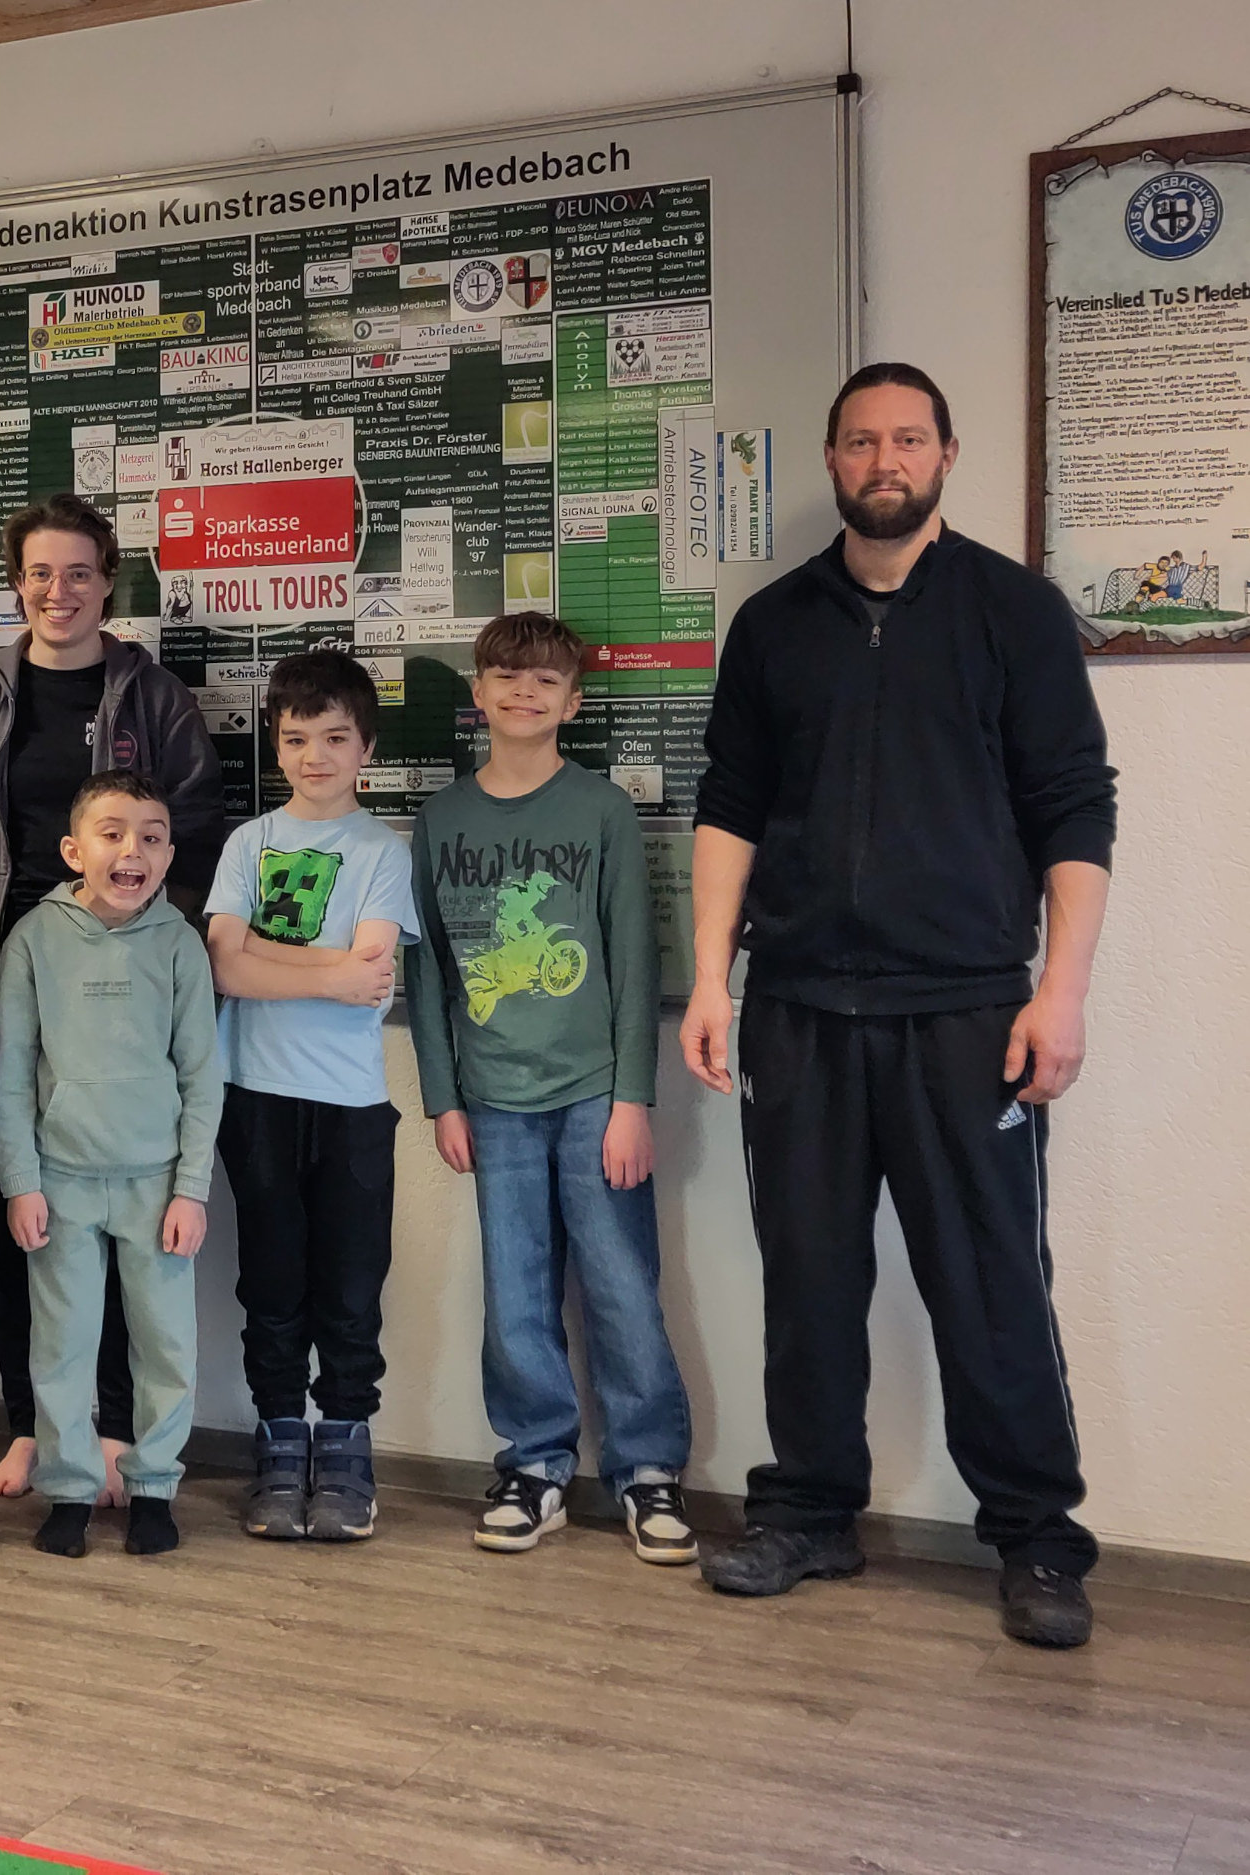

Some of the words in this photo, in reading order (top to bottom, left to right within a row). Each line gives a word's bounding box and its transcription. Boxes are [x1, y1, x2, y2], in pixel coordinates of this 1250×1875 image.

[159, 170, 431, 228] Kunstrasenplatz
[445, 143, 631, 193] Medebach
[1134, 176, 1207, 209] MEDEBACH
[1200, 195, 1215, 219] 1919
[411, 216, 439, 224] HANSE
[662, 221, 705, 231] Chancenlos
[1131, 212, 1144, 242] TUS
[402, 224, 447, 236] APOTHEKE
[453, 235, 472, 244] CDU
[479, 232, 498, 241] FWG
[506, 229, 523, 238] FDP
[530, 226, 548, 235] SPD
[572, 244, 608, 257] MGV
[612, 235, 688, 252] Medebach
[611, 254, 653, 263] Rebecca
[656, 249, 705, 260] Schnellen
[233, 262, 274, 277] Stadt-
[207, 275, 300, 299] sportverband
[73, 284, 144, 307] HUNOLD
[1056, 290, 1145, 313] Vereinslied
[1150, 286, 1190, 306] TuS
[217, 296, 291, 316] Medebach
[357, 305, 398, 315] Musikzug
[401, 300, 447, 311] Medebach
[74, 305, 144, 323] Malerbetrieb
[53, 321, 114, 336] Oldtimer-Club
[117, 317, 159, 331] Medebach
[163, 316, 177, 326] e.V.
[258, 329, 264, 337] In
[265, 325, 303, 337] Gedenken
[429, 325, 475, 337] brieden
[207, 333, 247, 342] Lebenslicht
[276, 340, 285, 348] an
[51, 346, 110, 361] HAST
[162, 352, 195, 369] BAU
[207, 344, 248, 365] KING
[258, 351, 281, 361] Werner
[282, 348, 304, 359] Althaus
[312, 349, 327, 357] Die
[328, 343, 394, 356] Montagsfrauen
[282, 358, 349, 371] ARCHITEKTURBÜRO
[574, 331, 591, 390] Anonym
[336, 379, 375, 390] Berthold
[387, 377, 412, 385] Sven
[415, 374, 446, 384] Sälzer
[661, 384, 710, 394] Vorstand
[314, 396, 328, 404] mit
[331, 394, 360, 403] Colleg
[363, 390, 408, 399] Treuhand
[411, 386, 442, 396] GmbH
[614, 390, 652, 399] Thomas
[659, 395, 703, 405] Fußball
[33, 408, 51, 416] ALTE
[52, 406, 83, 415] HERREN
[85, 400, 138, 412] MANNSCHAFT
[140, 399, 157, 407] 2010
[316, 408, 325, 416] u.
[327, 404, 374, 415] Busreisen
[386, 401, 406, 410] Taxi
[408, 399, 439, 409] Sälzer
[612, 401, 653, 411] Grosche
[365, 440, 408, 449] Praxis
[413, 437, 432, 445] Dr.
[438, 432, 488, 445] Förster
[121, 452, 154, 466] Metzgerei
[358, 450, 403, 462] ISENBERG
[405, 443, 501, 458] BAUUNTERNEHMUNG
[201, 460, 238, 476] Horst
[243, 456, 344, 475] Hallenberger
[119, 473, 156, 484] Hammecke
[406, 482, 499, 497] Aufstiegsmannschaft
[750, 479, 758, 513] FRANK
[663, 427, 678, 584] Antriebstechnologie
[689, 448, 708, 557] ANFOTEC
[371, 513, 382, 521] an
[562, 506, 600, 517] SIGNAL
[603, 504, 635, 513] IDUNA
[205, 515, 300, 539] Sparkasse
[373, 523, 399, 532] Howe
[404, 519, 451, 528] PROVINZIAL
[455, 522, 502, 532] Wander-
[404, 532, 451, 543] Versicherung
[466, 537, 489, 547] club
[206, 532, 349, 560] Hochsauerland
[417, 547, 437, 557] Willi
[469, 551, 485, 563] '97
[410, 563, 444, 574] Hellwig
[403, 578, 451, 588] Medebach
[203, 579, 262, 613] TROLL
[270, 574, 348, 612] TOURS
[676, 617, 700, 628] SPD
[661, 630, 714, 640] Medebach
[614, 652, 652, 661] Sparkasse
[614, 661, 671, 669] Hochsauerland
[622, 740, 651, 752] Ofen
[618, 753, 656, 764] Kaiser
